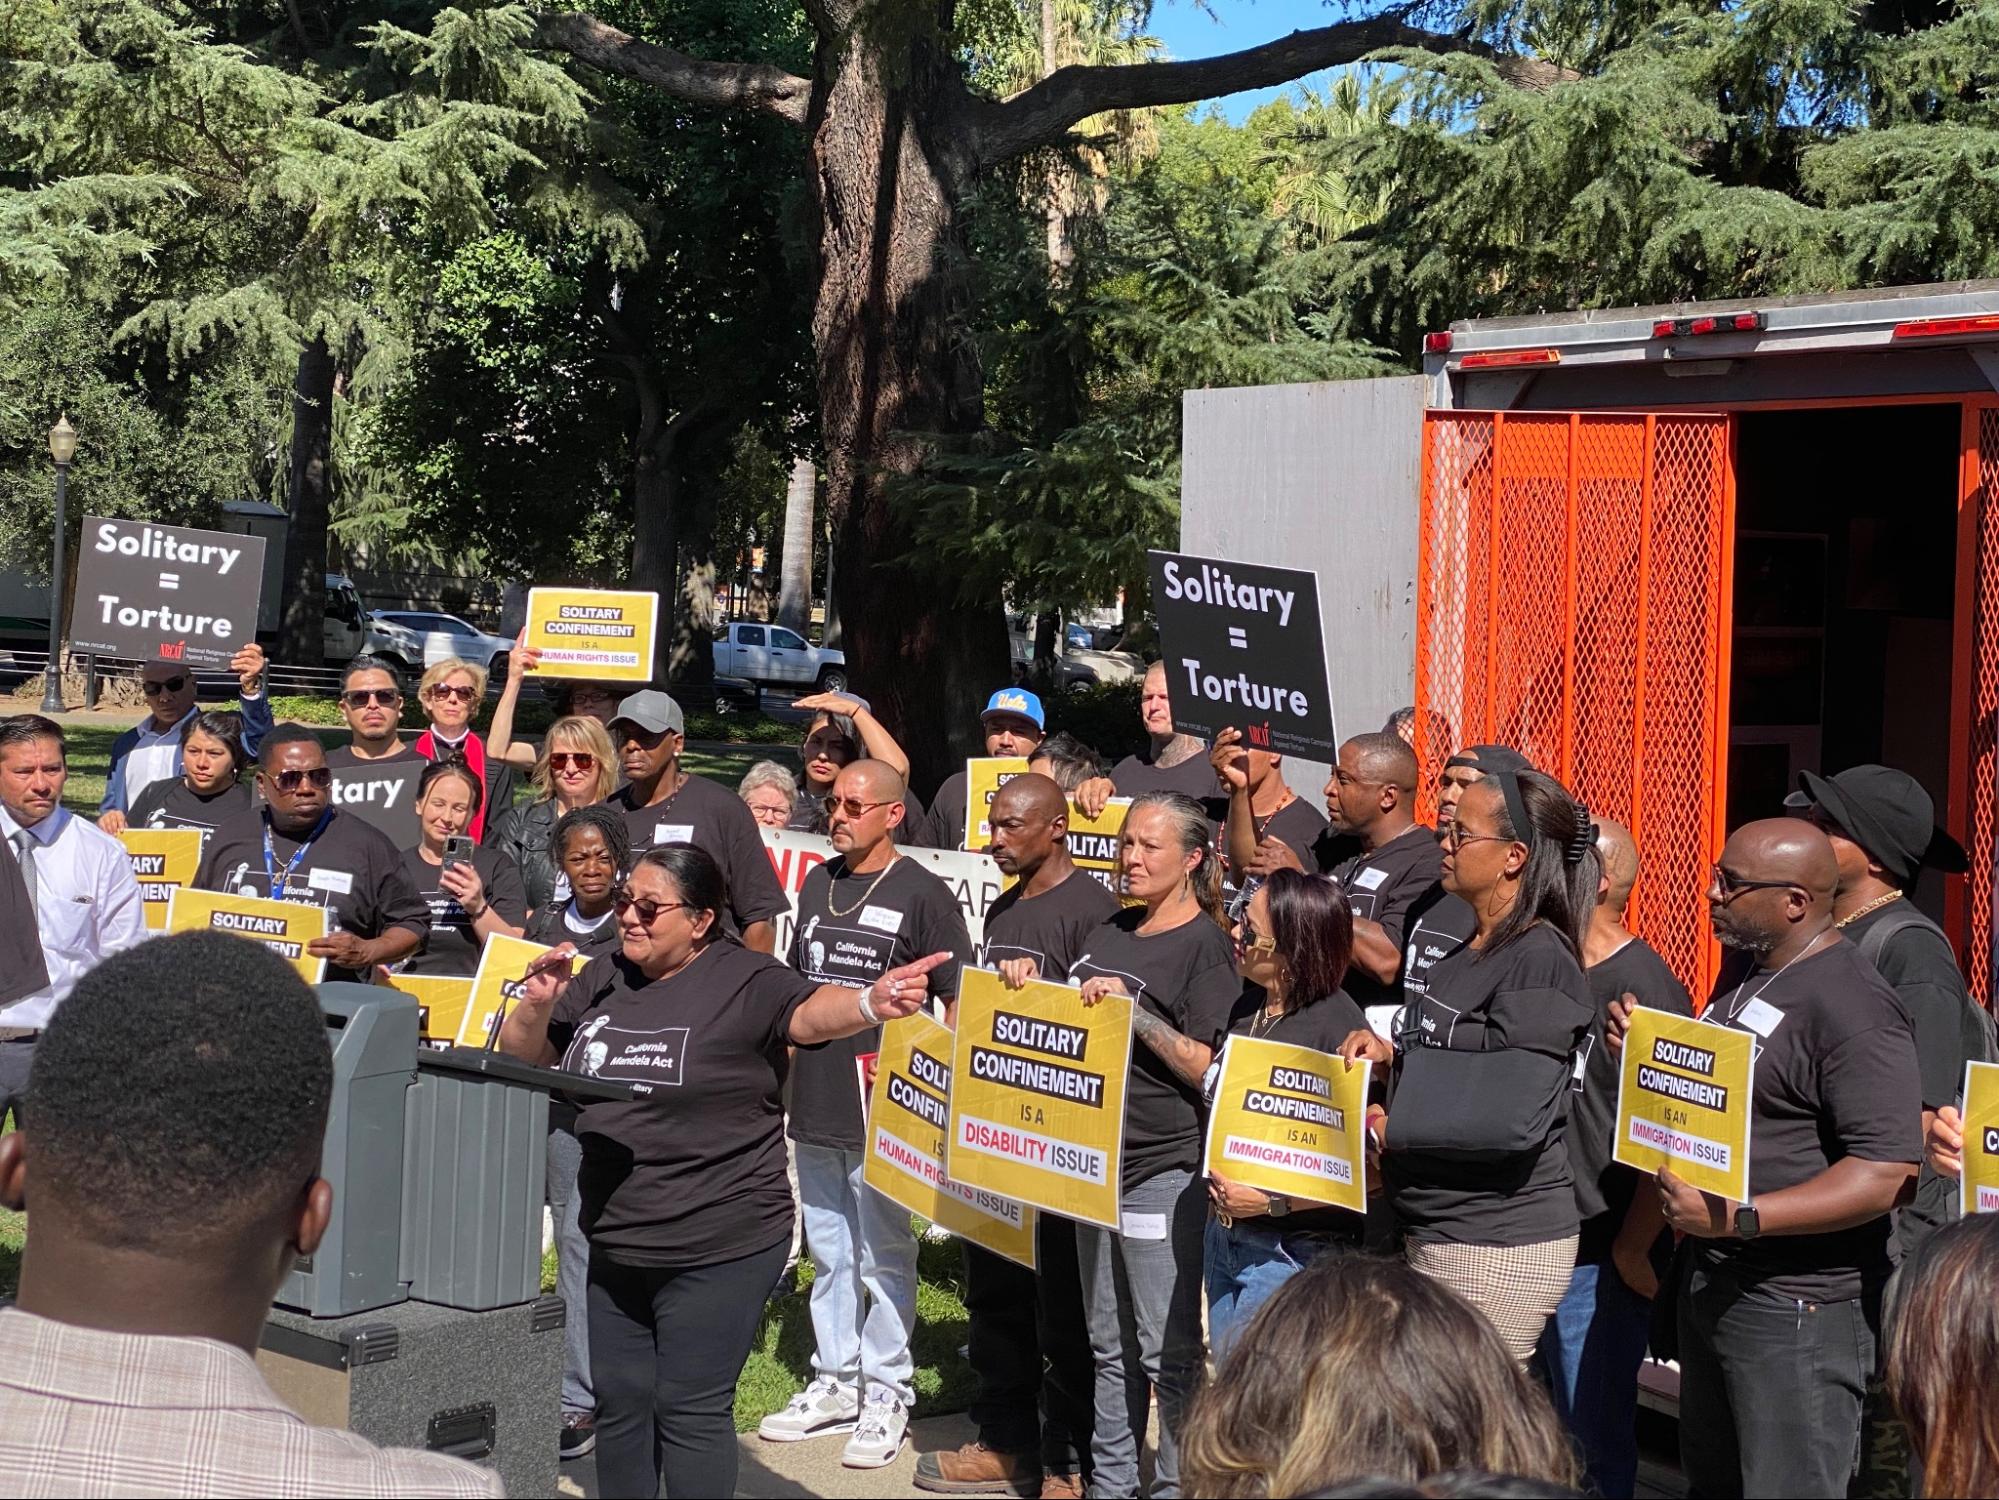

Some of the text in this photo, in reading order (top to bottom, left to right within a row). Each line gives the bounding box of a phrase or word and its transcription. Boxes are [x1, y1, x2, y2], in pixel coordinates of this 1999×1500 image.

[95, 523, 241, 574] Solitary
[1163, 561, 1295, 626] Solitary
[98, 595, 233, 638] Torture
[561, 606, 621, 619] SOLITARY
[546, 622, 633, 636] CONFINEMENT
[541, 652, 636, 664] HUMAN RIGHTS ISSUE
[592, 641, 598, 649] A
[1182, 658, 1308, 717] Torture
[331, 779, 404, 808] tary
[129, 857, 163, 873] ARY
[212, 913, 285, 934] SOLITARY
[829, 953, 882, 970] Mandela Act
[836, 941, 877, 957] California
[996, 1015, 1084, 1056] SOLITARY
[610, 1055, 673, 1068] Mandela Act
[912, 1052, 949, 1090] SOLI
[1655, 1041, 1713, 1073] SOLITARY
[973, 1050, 1101, 1102] CONFINEMENT
[1273, 1069, 1330, 1097] SOLITARY
[1639, 1067, 1725, 1108] CONFINEMENT
[1020, 1104, 1045, 1125] IS A
[1248, 1092, 1342, 1128] CONFINEMENT
[1664, 1106, 1687, 1126] IS AN
[933, 1139, 944, 1157] IS
[965, 1122, 1099, 1177] DISABILITY ISSUE
[1287, 1129, 1317, 1146] IS AN
[1632, 1121, 1727, 1165] IMMIGRATION ISSUE
[1229, 1141, 1350, 1179] IMMIGRATION ISSUE
[879, 1136, 922, 1173] HUMAN
[976, 1190, 1019, 1222] ISSUE
